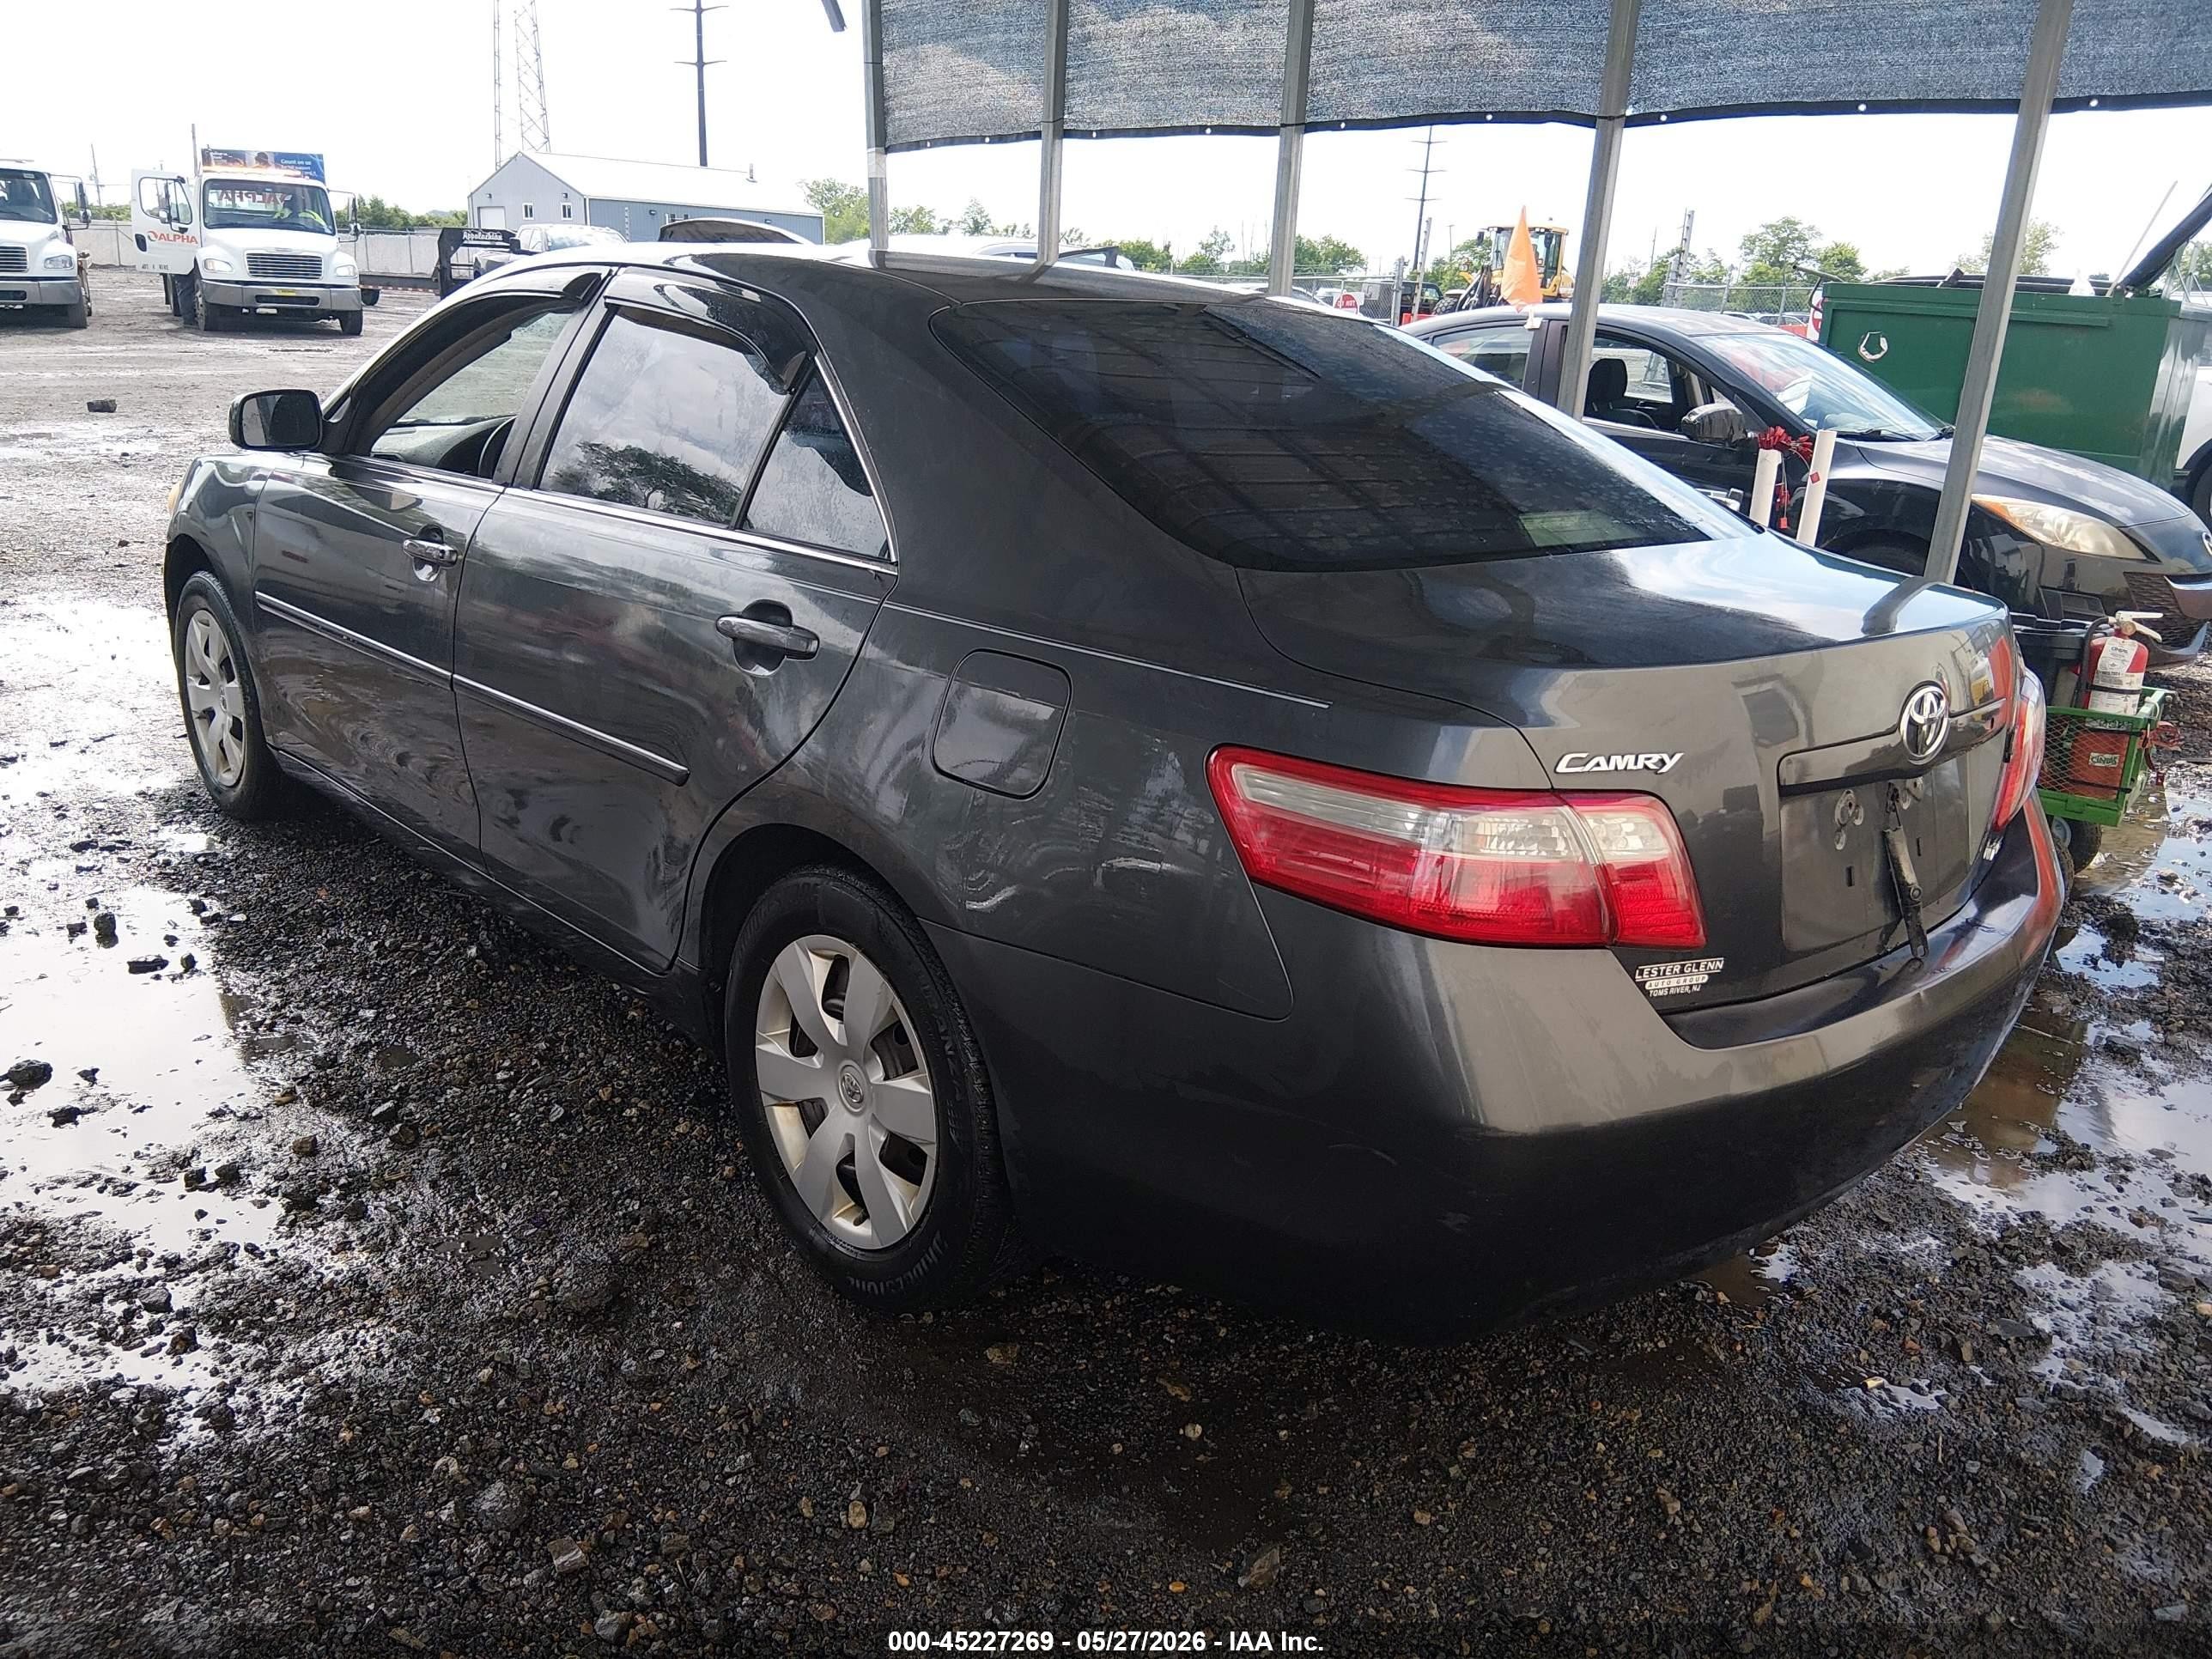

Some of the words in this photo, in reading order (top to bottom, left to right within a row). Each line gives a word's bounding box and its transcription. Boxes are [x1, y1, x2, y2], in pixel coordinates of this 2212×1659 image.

[158, 233, 199, 245] ALPHA
[1555, 752, 1686, 775] CAMRY
[1635, 965, 1680, 979] LESTER
[1684, 961, 1724, 973] GLENN
[1647, 980, 1672, 988] AUTO
[1675, 975, 1706, 985] GROUP
[1650, 988, 1668, 997] TOMS
[1668, 985, 1691, 995] RIVER,
